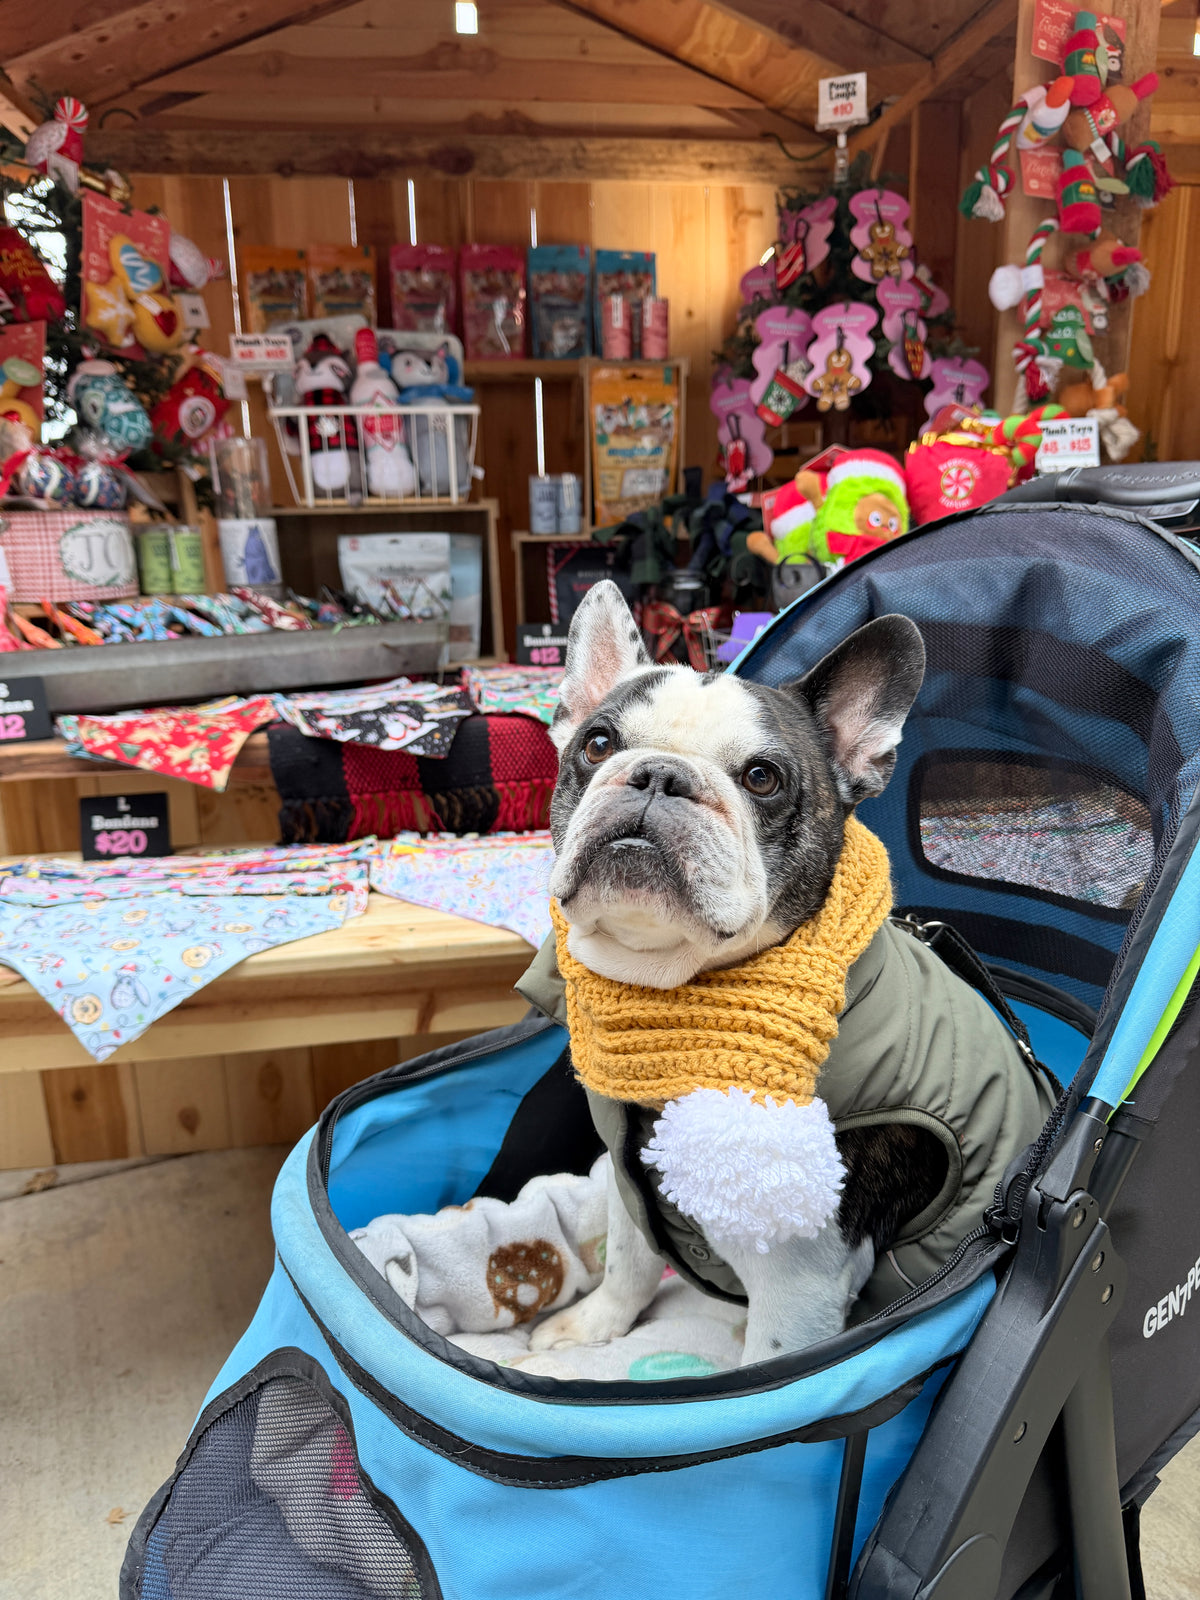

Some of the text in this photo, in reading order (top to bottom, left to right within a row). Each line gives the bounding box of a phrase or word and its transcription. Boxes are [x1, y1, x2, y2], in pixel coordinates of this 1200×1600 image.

[1070, 422, 1093, 437] Toys
[530, 647, 561, 665] $12
[0, 714, 26, 740] 12
[116, 796, 131, 812] L
[91, 813, 159, 831] Bandana
[95, 829, 149, 855] $20
